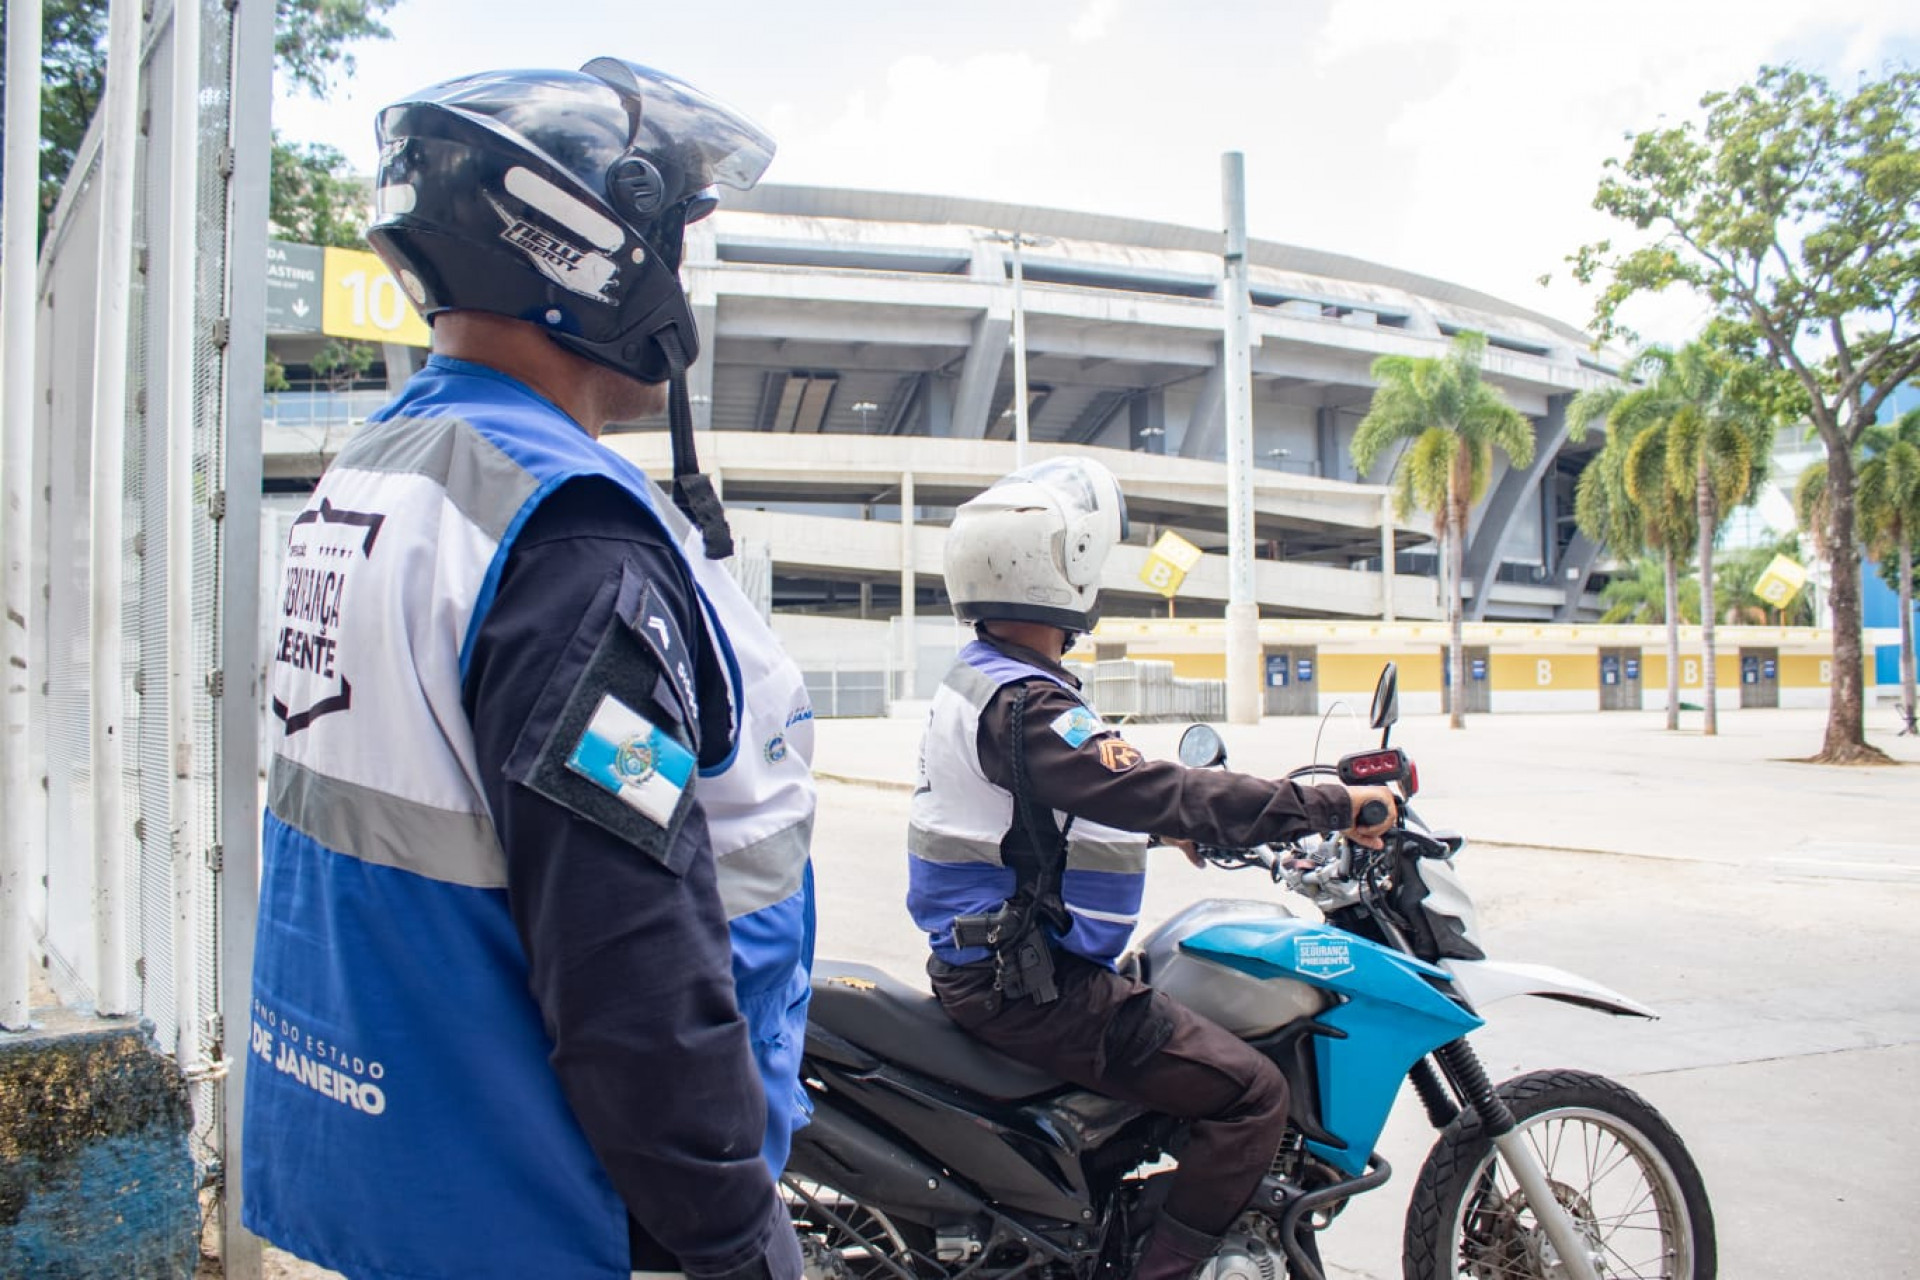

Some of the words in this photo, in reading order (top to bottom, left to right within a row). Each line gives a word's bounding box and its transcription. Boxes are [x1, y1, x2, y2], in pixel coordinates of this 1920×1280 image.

[340, 271, 405, 330] 10
[1149, 561, 1172, 588] B
[1536, 659, 1552, 685] B
[1684, 660, 1698, 684] B
[1819, 660, 1833, 683] B
[281, 1019, 299, 1043] DO
[306, 1035, 385, 1079] ESTADO
[253, 1020, 273, 1063] DE
[276, 1042, 386, 1115] JANEIRO
